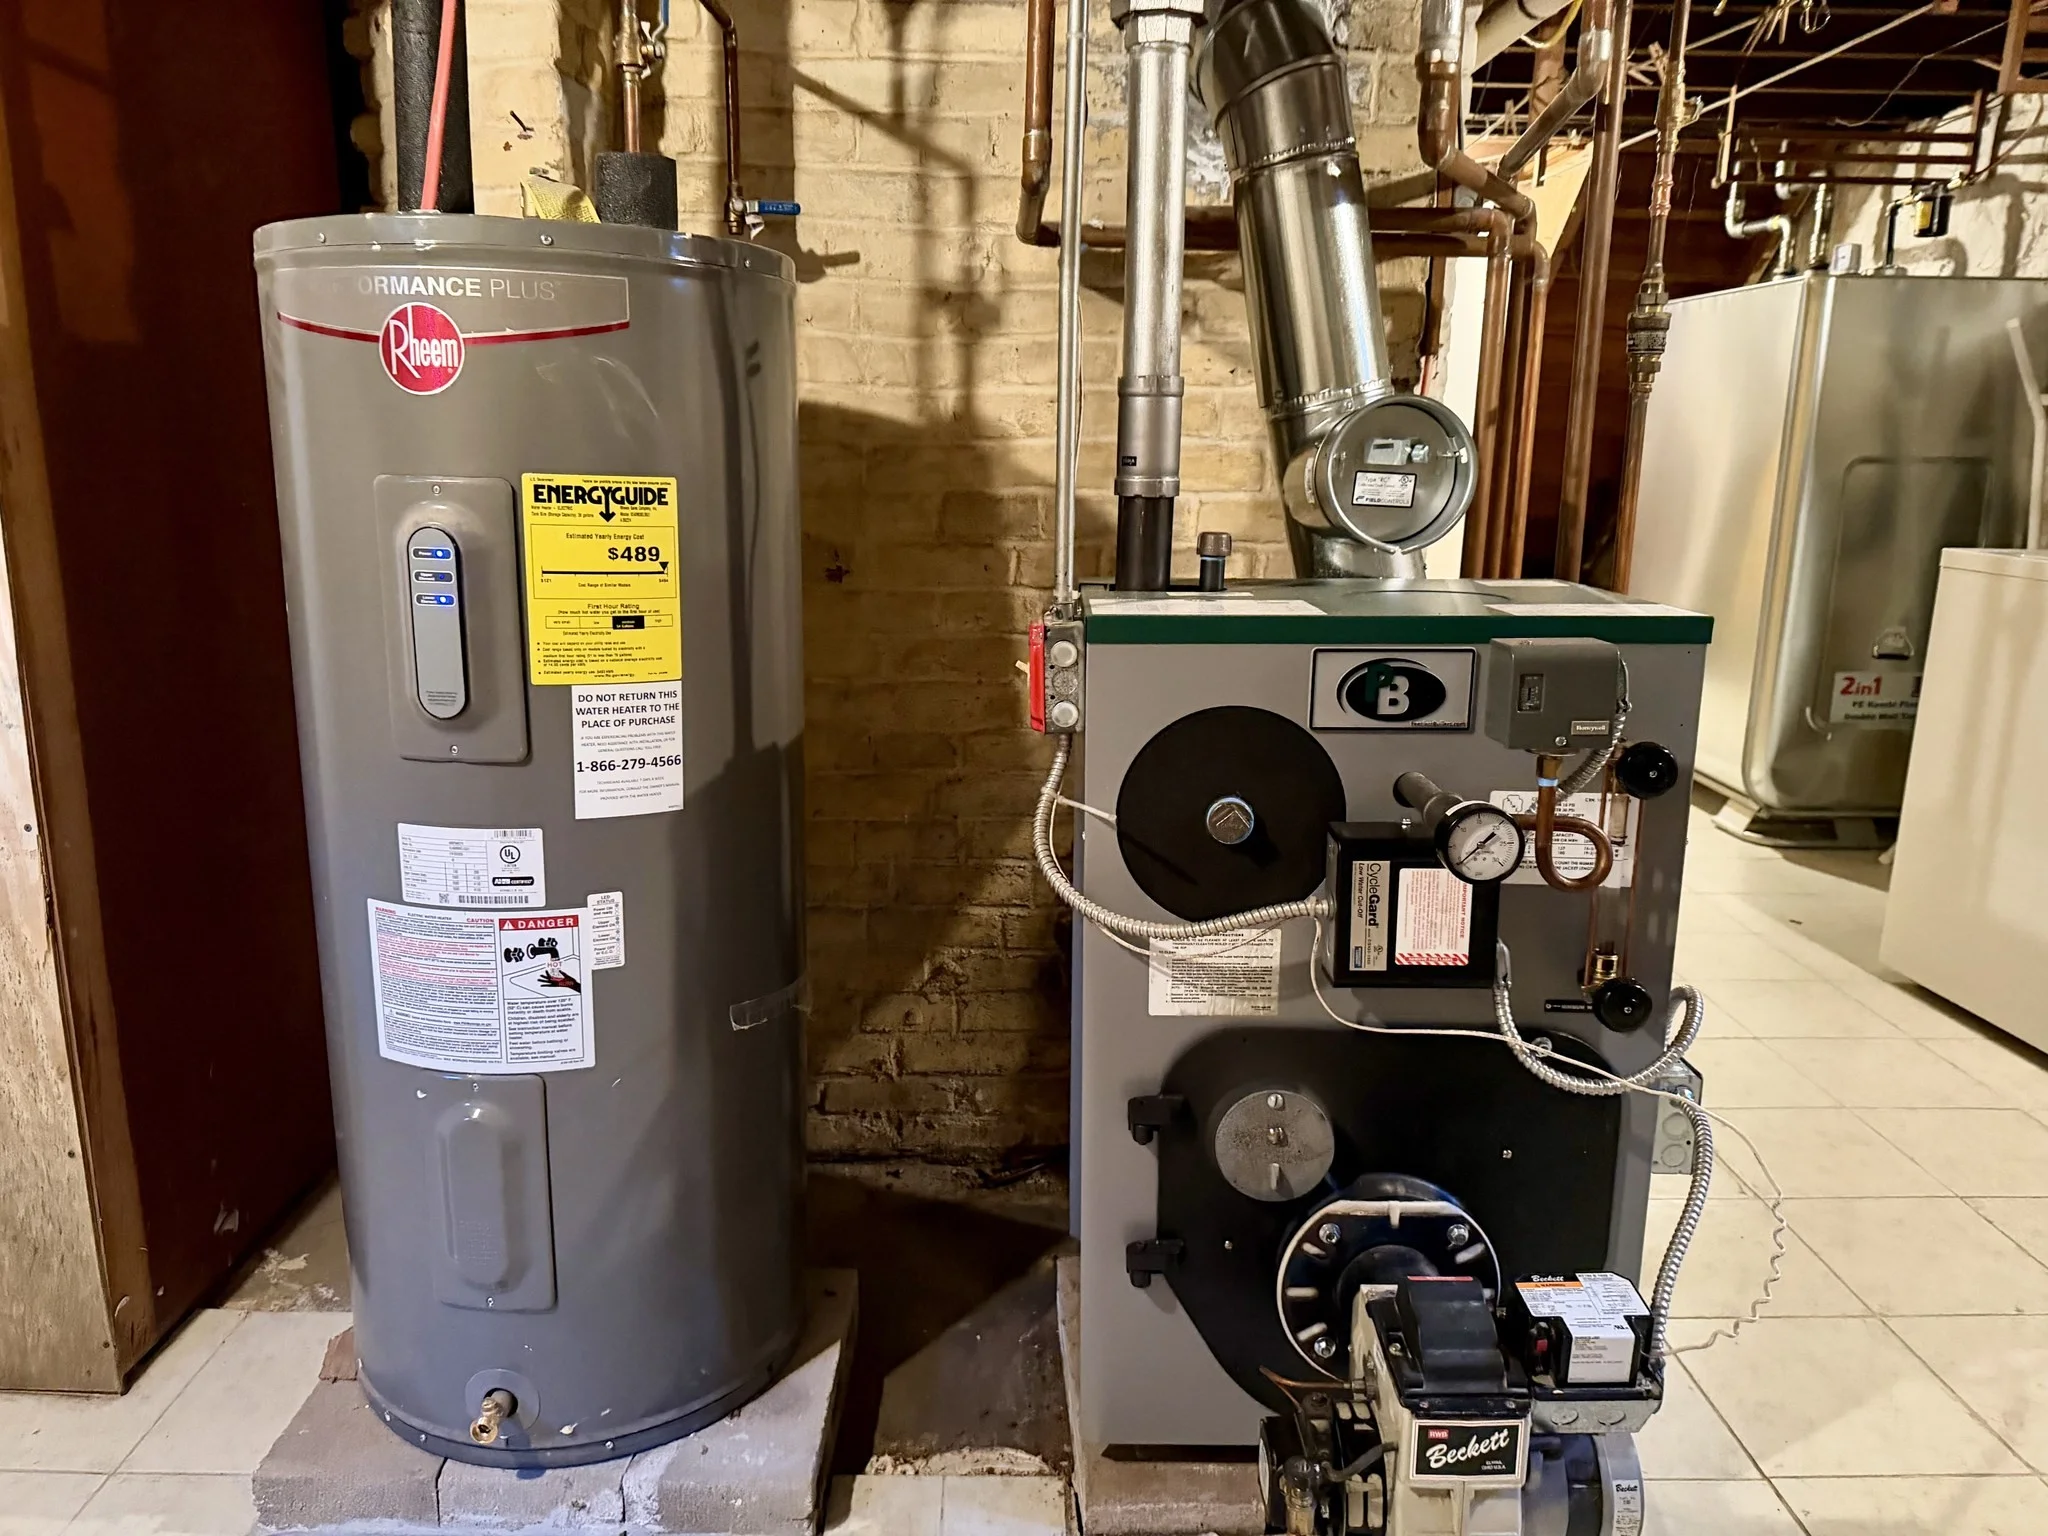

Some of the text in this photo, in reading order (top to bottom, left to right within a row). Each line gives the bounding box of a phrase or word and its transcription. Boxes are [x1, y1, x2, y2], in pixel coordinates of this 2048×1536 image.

[357, 275, 556, 300] ORMANCE PLUS
[388, 304, 459, 378] Rheem
[533, 484, 669, 507] ENERGYGUIDE
[614, 534, 631, 542] Energy
[608, 546, 660, 562] $489
[1840, 674, 1882, 696] 2in1
[578, 690, 677, 702] DO NOT RETURN THIS
[576, 703, 680, 715] WATER HEATER TO THE
[582, 716, 675, 728] PLACE OF PURCHASE
[576, 754, 682, 772] 1-866-279-4566
[505, 849, 516, 860] UL
[1367, 863, 1381, 927] CycleGard
[518, 918, 574, 929] DANGER
[1426, 1428, 1510, 1468] Beckett
